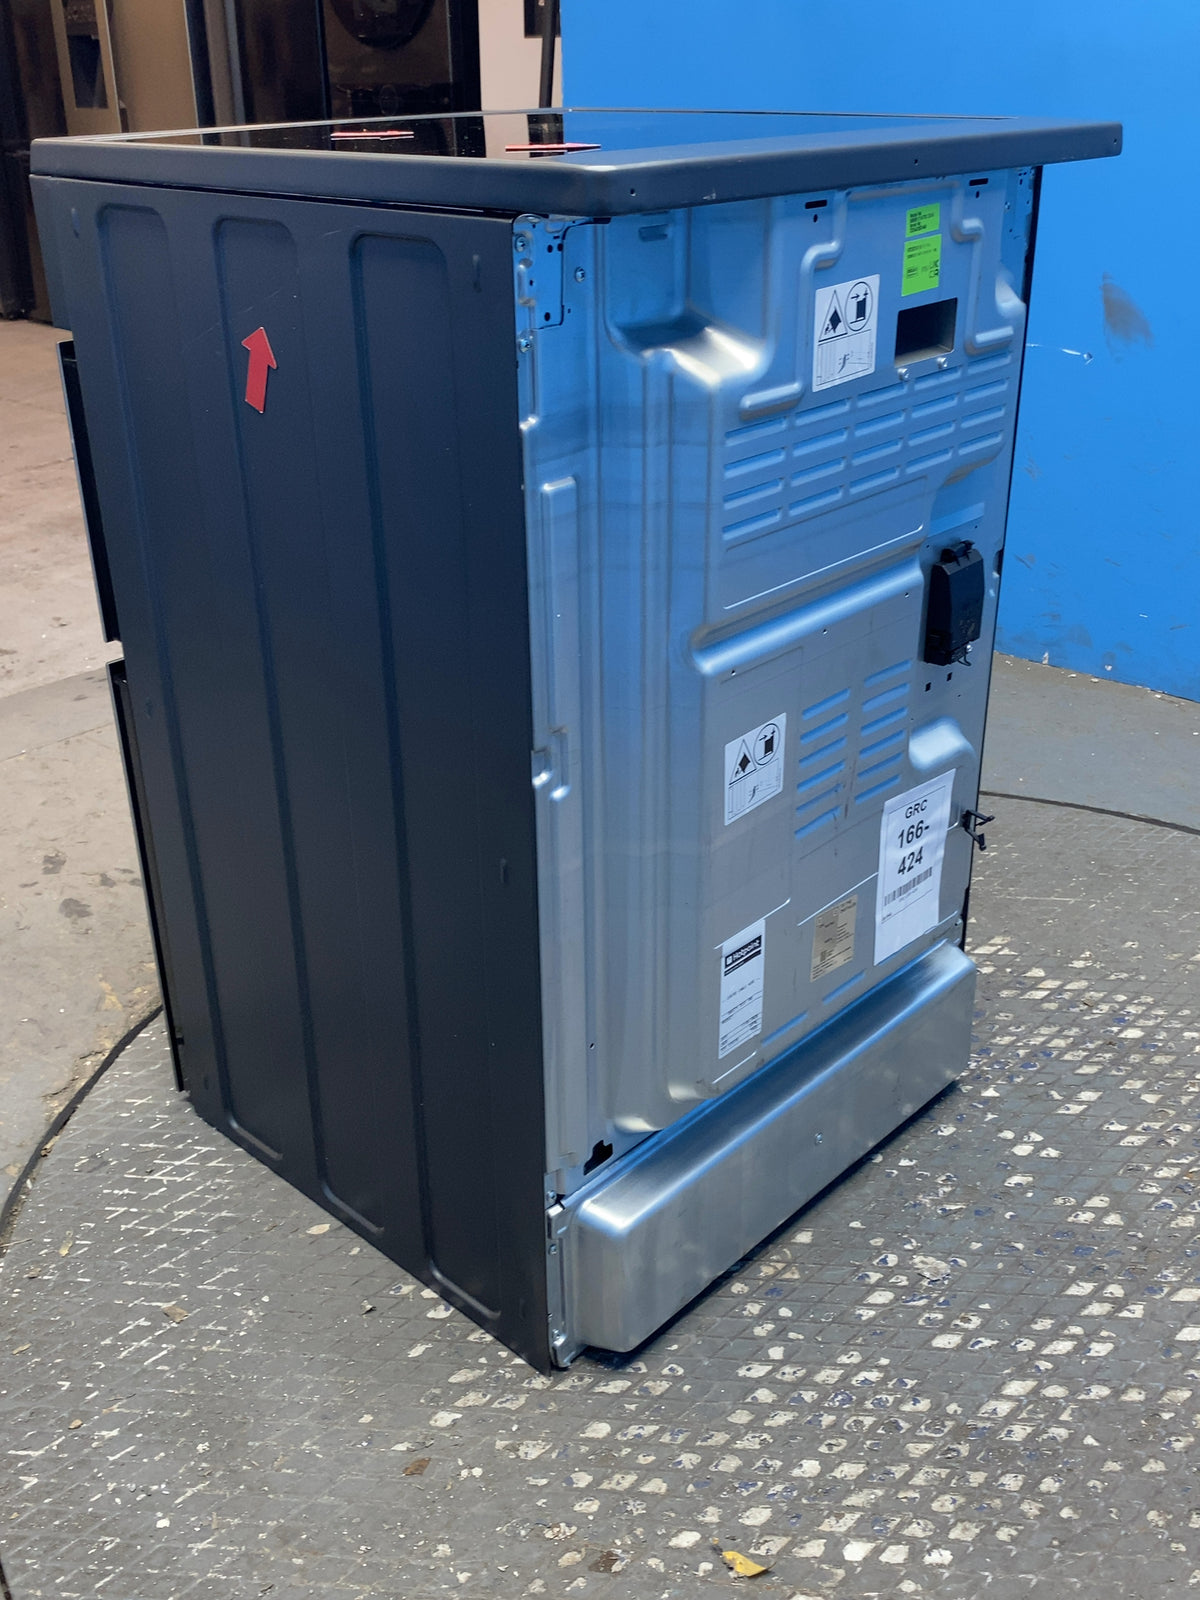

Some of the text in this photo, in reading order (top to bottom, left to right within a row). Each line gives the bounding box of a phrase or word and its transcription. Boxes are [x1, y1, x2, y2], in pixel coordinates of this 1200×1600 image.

[905, 799, 928, 819] GRC
[897, 820, 930, 848] 166-
[897, 846, 924, 876] 424
[732, 939, 760, 961] Hotpoint
